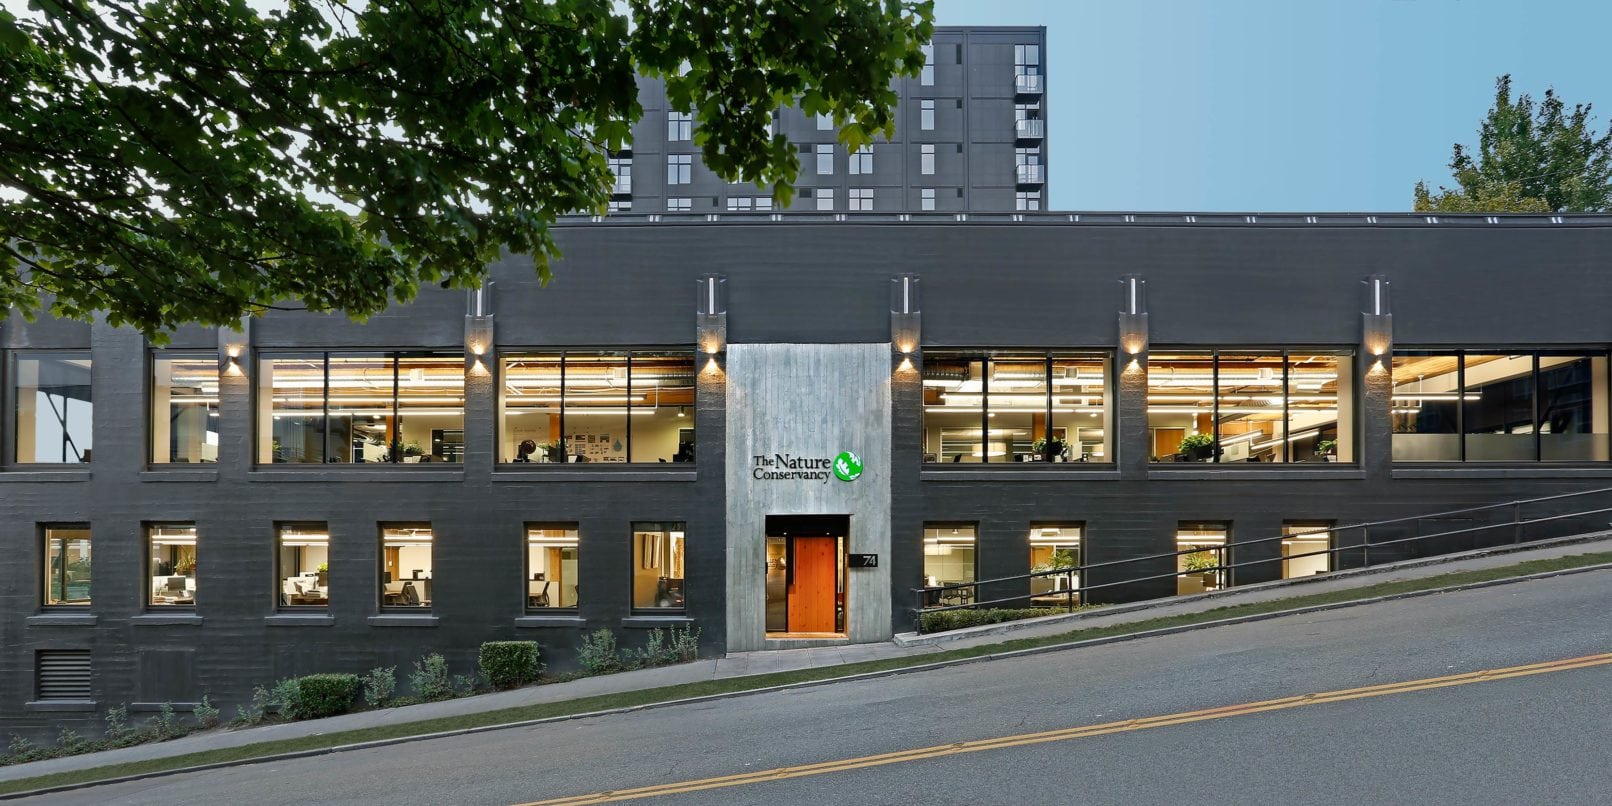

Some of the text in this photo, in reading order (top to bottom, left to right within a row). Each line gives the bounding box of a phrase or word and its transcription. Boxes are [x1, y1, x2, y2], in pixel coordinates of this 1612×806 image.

[753, 454, 831, 469] The Nature
[753, 468, 831, 484] Conservancy
[863, 555, 876, 566] 74
